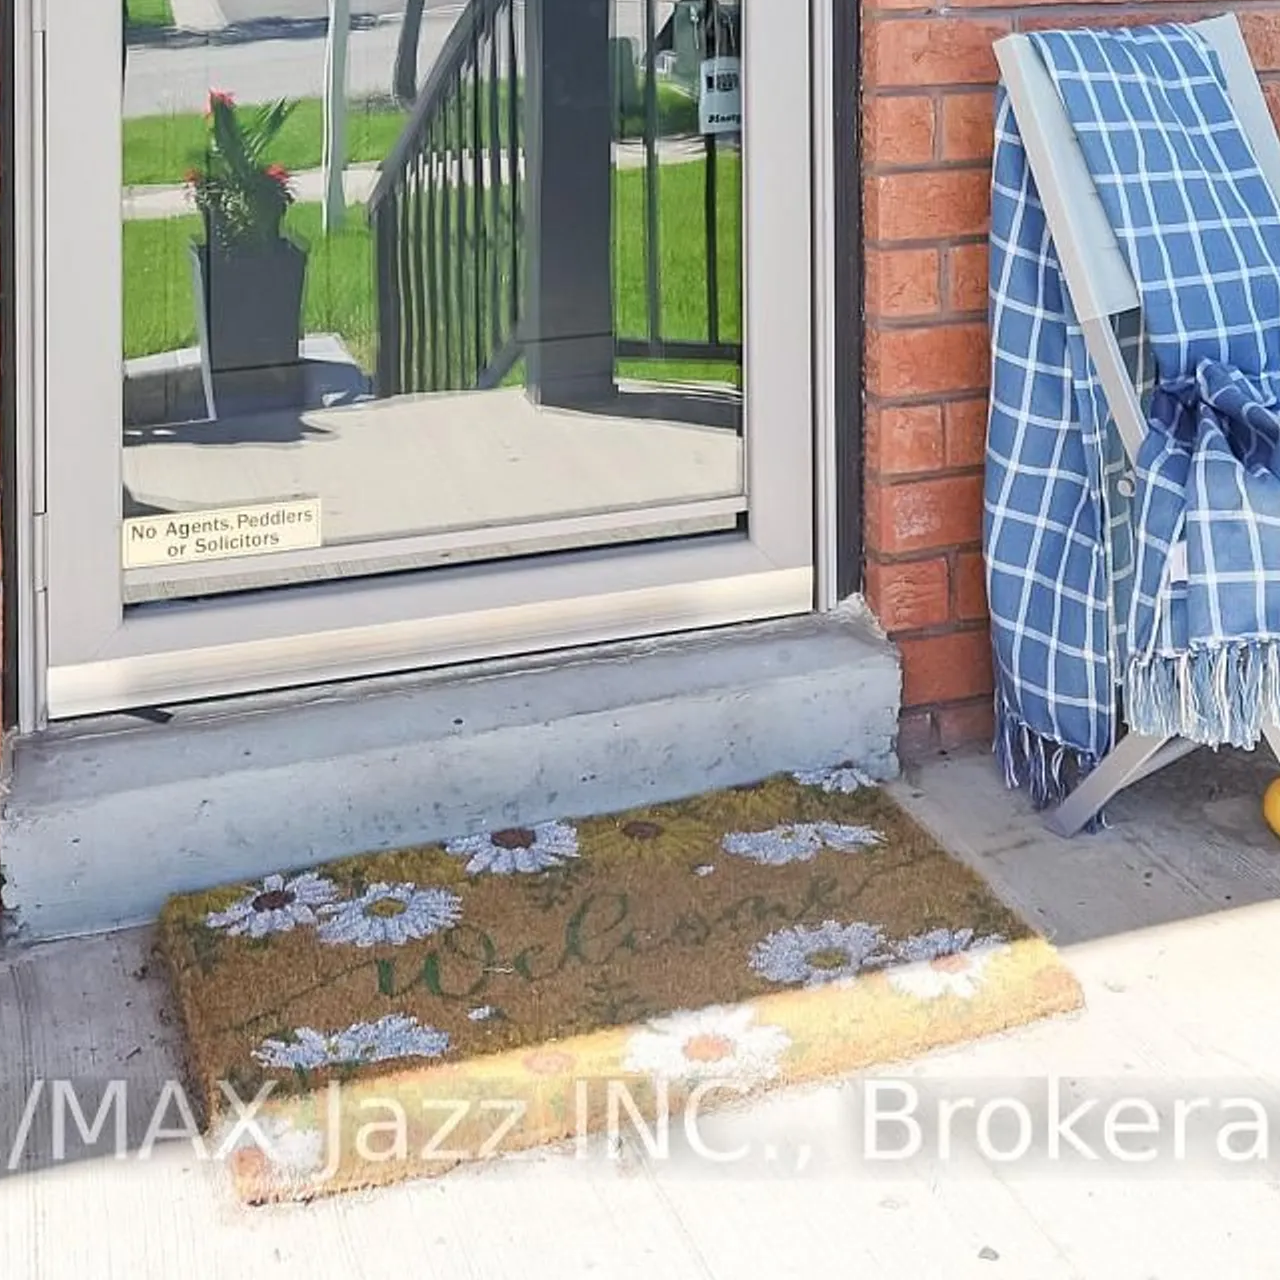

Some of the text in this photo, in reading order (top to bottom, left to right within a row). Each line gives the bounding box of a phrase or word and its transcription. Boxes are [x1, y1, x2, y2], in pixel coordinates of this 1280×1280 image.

[131, 525, 157, 542] No
[237, 509, 313, 529] Peddlers
[167, 532, 280, 557] or Solicitors
